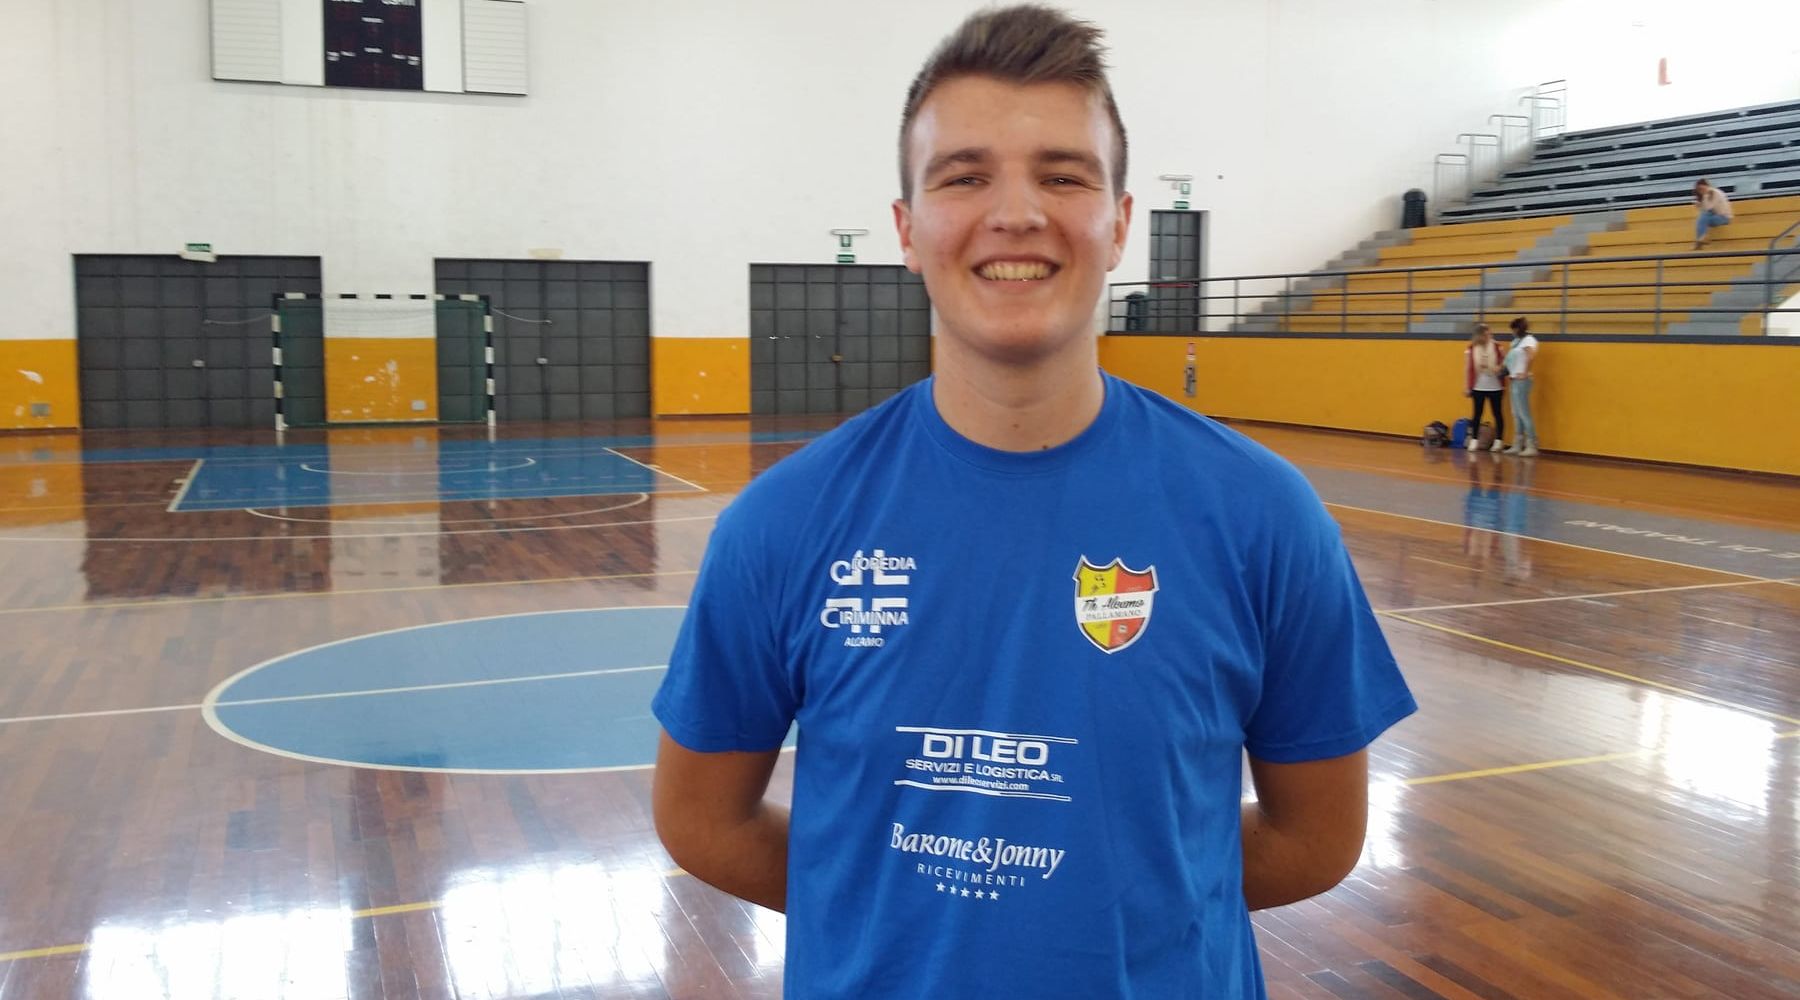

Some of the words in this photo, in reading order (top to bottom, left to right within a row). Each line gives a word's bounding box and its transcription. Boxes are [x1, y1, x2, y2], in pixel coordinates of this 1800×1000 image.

[820, 607, 910, 628] CIRIMINNA
[844, 637, 885, 647] ALCAMO
[922, 733, 965, 759] DI
[971, 736, 1049, 766] LEO
[905, 759, 961, 773] SERVIZI
[963, 763, 976, 774] E
[975, 764, 1050, 781] LOGISTICA
[932, 775, 1030, 791] www.dileoservizi.com
[917, 863, 1026, 887] RICEVIMENTI
